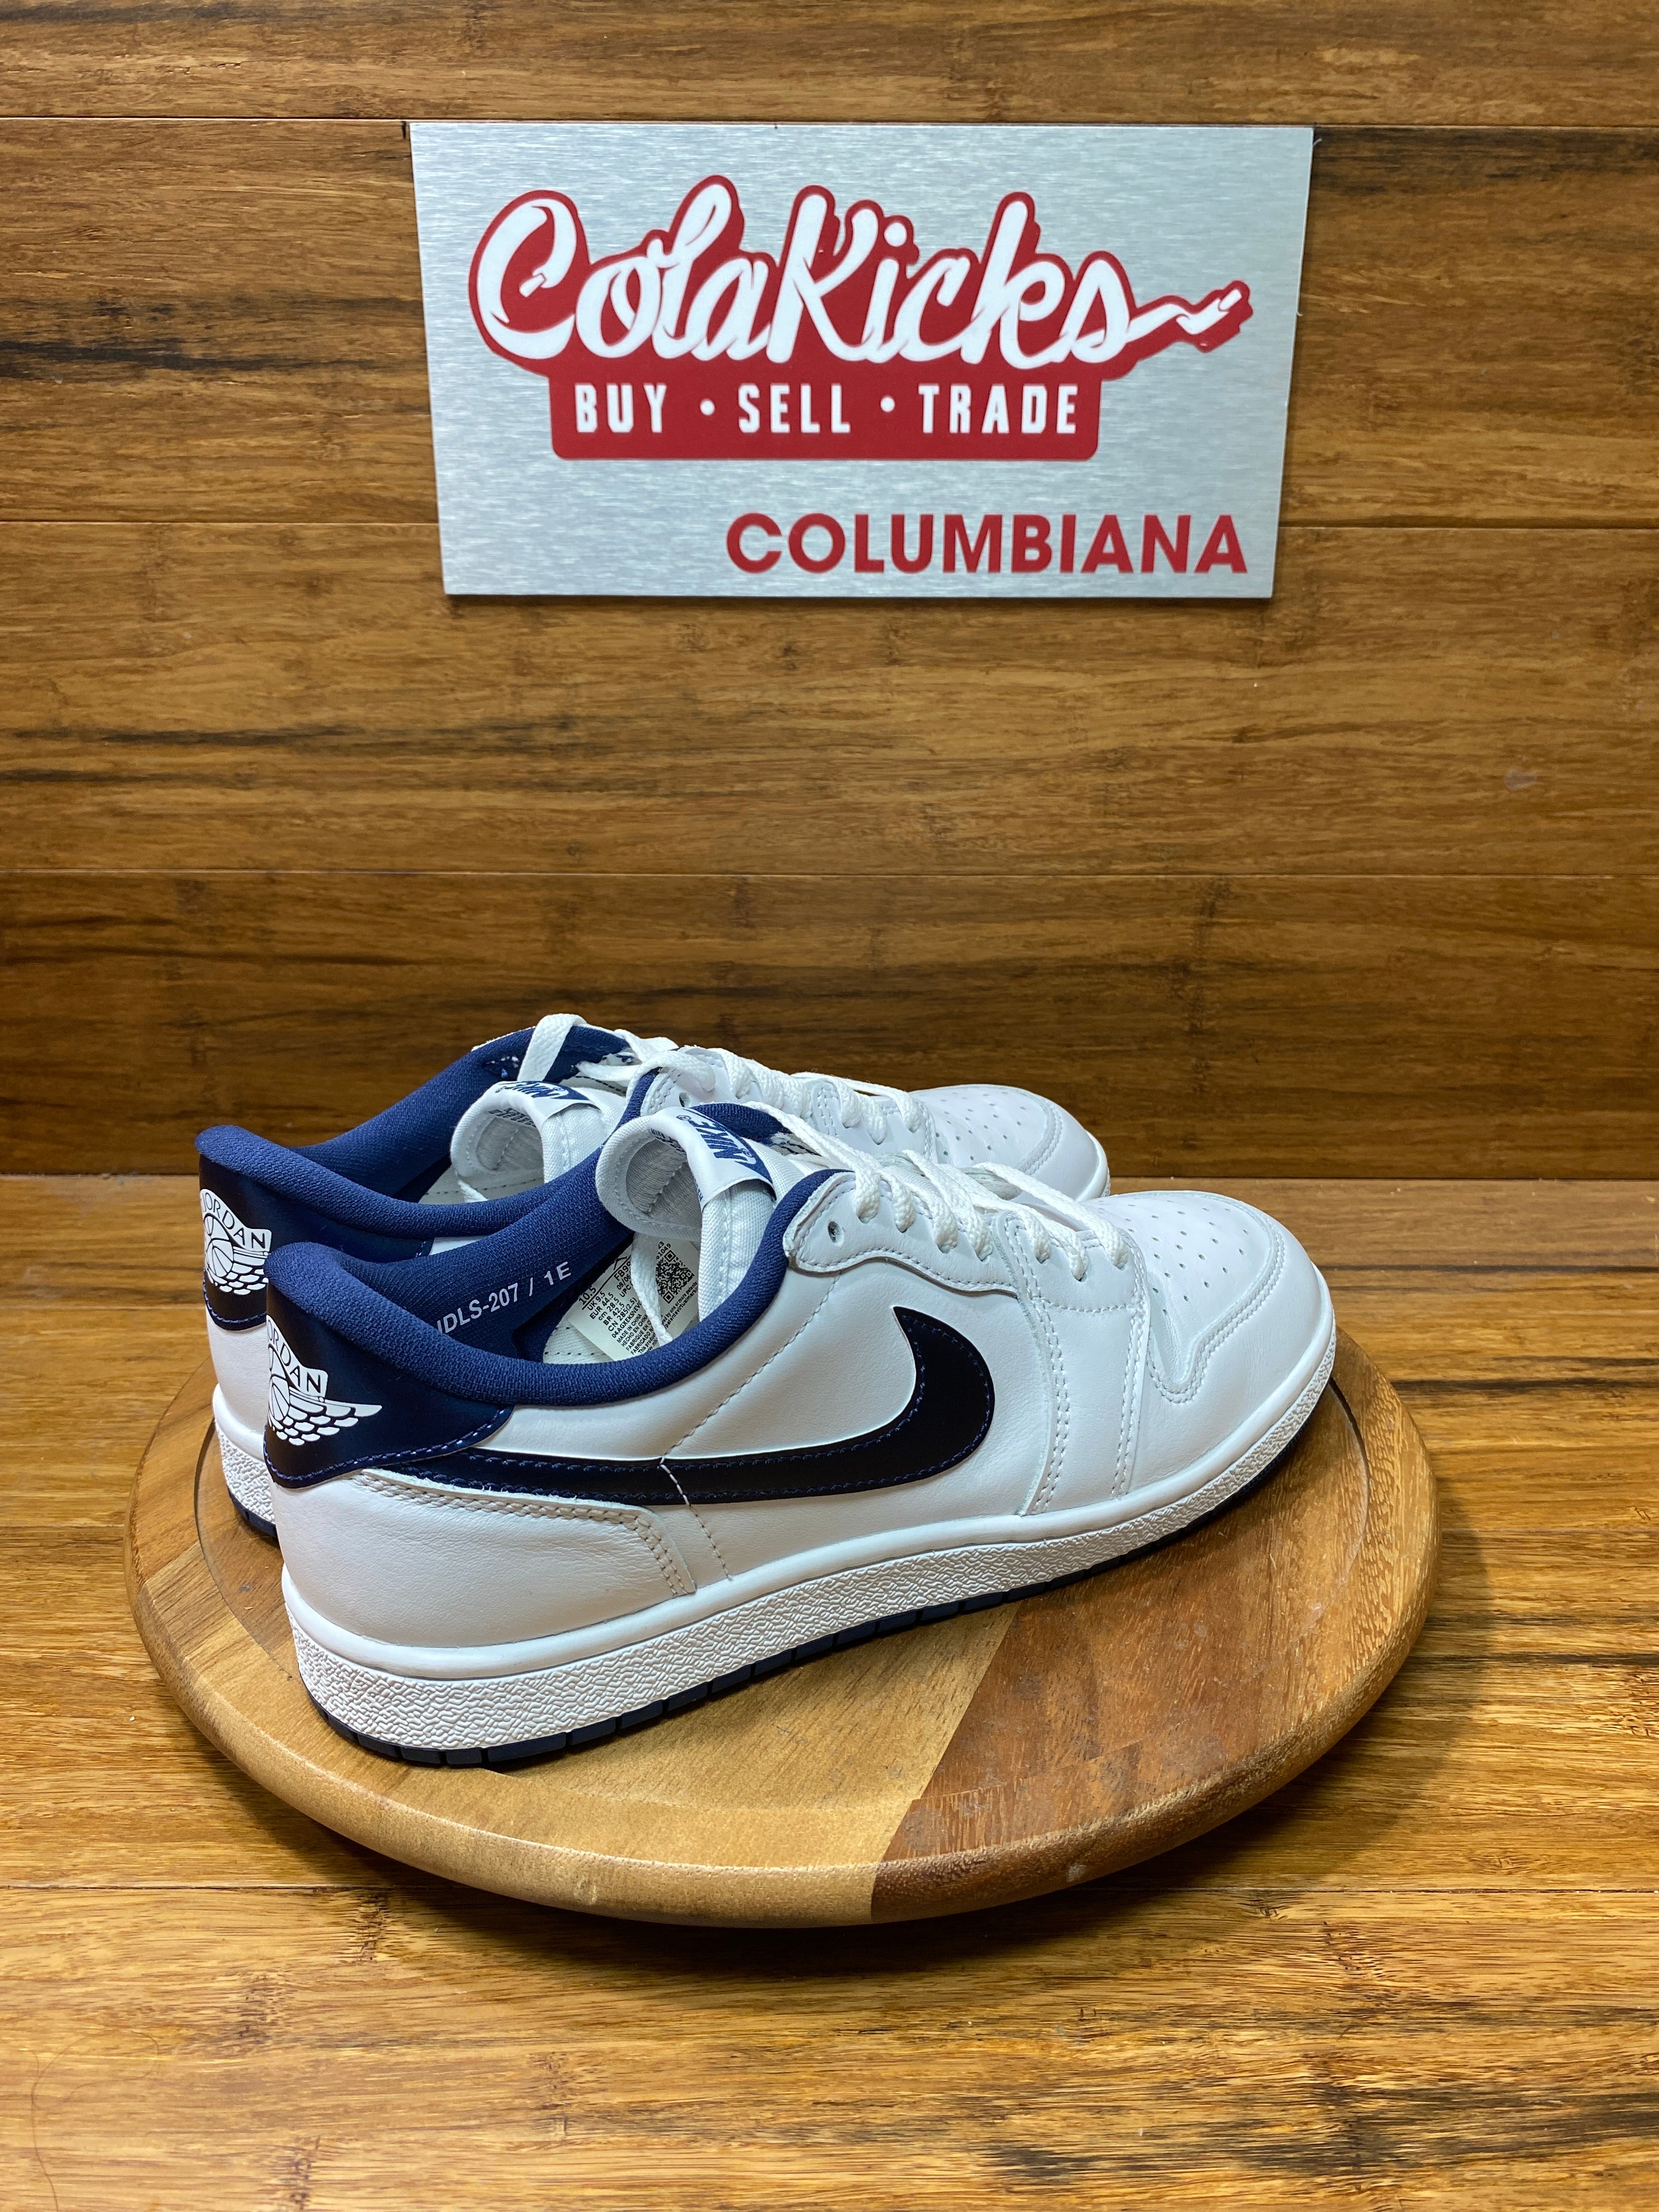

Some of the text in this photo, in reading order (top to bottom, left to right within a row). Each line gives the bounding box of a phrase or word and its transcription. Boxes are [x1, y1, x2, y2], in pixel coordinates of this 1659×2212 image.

[476, 181, 1244, 371] ColaKicks
[574, 383, 1078, 435] BUY SELL TRADE
[726, 512, 1247, 574] COLUMBIANA
[688, 1120, 748, 1159] NIKE
[544, 1261, 572, 1285] 1E
[617, 1271, 631, 1290] 09/06
[579, 1286, 596, 1305] 10.5
[587, 1291, 606, 1311] UK 9.5
[619, 1284, 631, 1297] UPC
[590, 1292, 614, 1319] EUR 44.5
[599, 1297, 619, 1321] cm 28.5
[603, 1302, 624, 1325] BR 42.5
[608, 1321, 618, 1331] CN
[617, 1330, 629, 1343] MADE
[631, 1314, 642, 1327] CHINA
[621, 1332, 634, 1347] HECHO
[626, 1330, 644, 1351] FABRIQUE
[630, 1332, 650, 1355] FABRICADO
[267, 1319, 321, 1393] ORDAN
